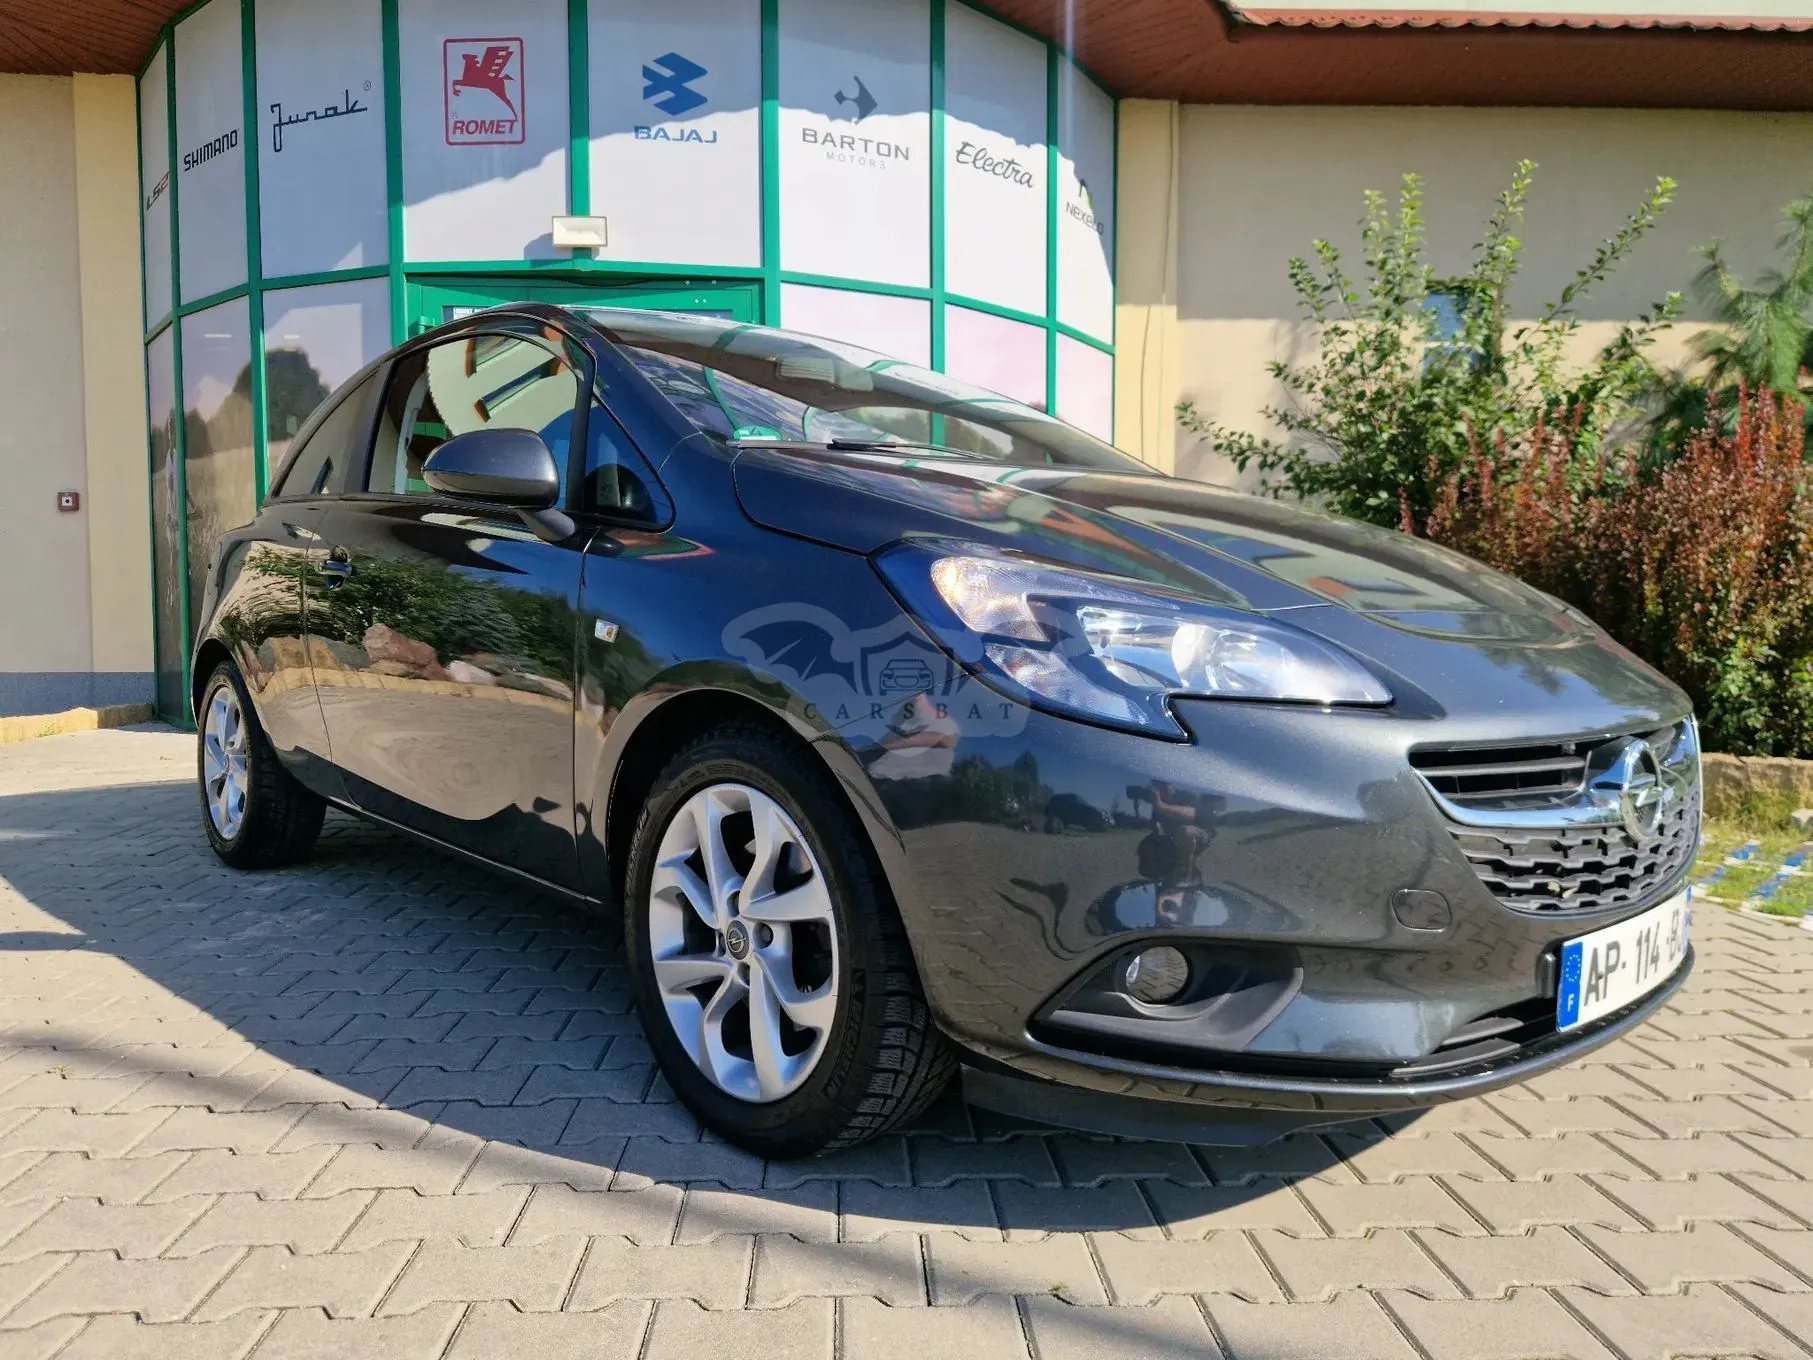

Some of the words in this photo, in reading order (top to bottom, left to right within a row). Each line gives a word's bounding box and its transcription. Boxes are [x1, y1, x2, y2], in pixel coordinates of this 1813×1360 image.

[270, 88, 368, 153] Junak
[452, 119, 518, 135] ROMET
[633, 125, 718, 144] BAJAJ
[183, 128, 238, 171] SHIMANO
[801, 127, 910, 161] BARTON
[825, 151, 887, 170] MOTORS
[955, 140, 1034, 188] Electra
[146, 171, 169, 210] LS2
